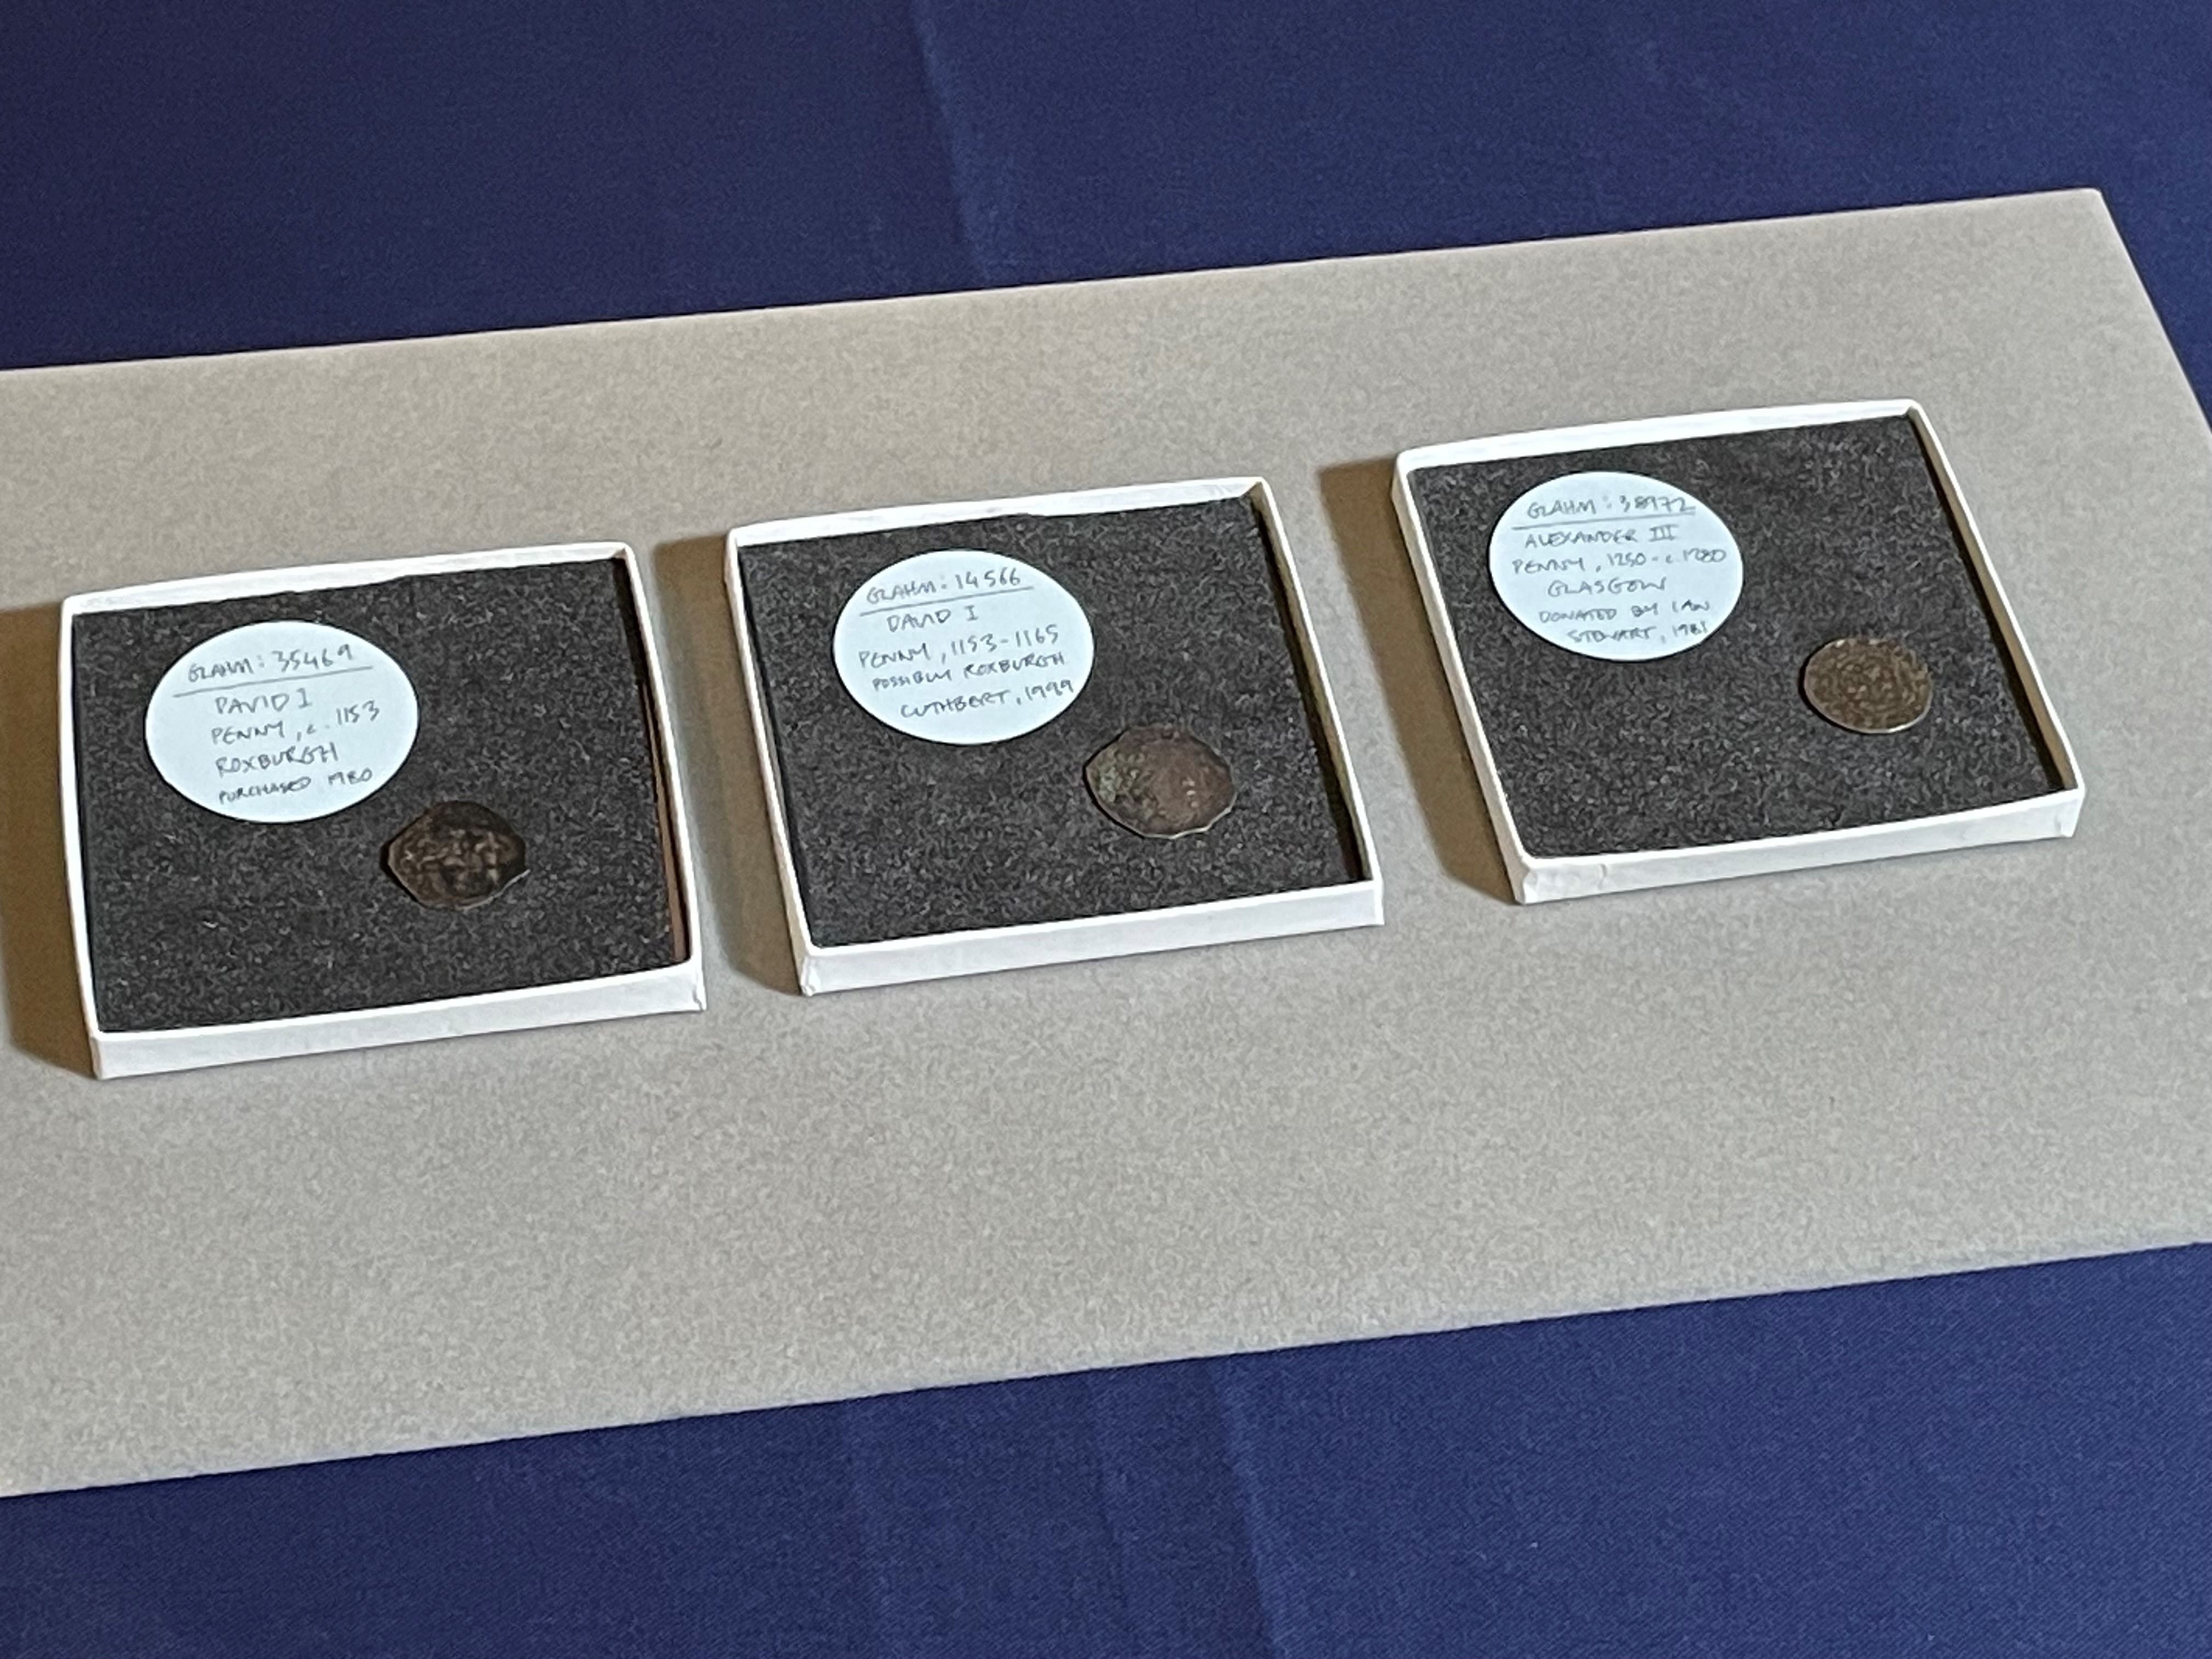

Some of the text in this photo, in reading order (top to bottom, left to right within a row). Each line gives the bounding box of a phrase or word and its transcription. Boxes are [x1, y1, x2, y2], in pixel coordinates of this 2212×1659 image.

[1525, 524, 1679, 549] ALEXANDER III
[1548, 577, 1667, 597] GLASGOW
[887, 605, 978, 632] DAVID I
[1538, 599, 1710, 623] DONATED BY IAN
[872, 651, 1065, 691] POSSIBLY ROXBURGH
[216, 688, 312, 713] DAVID I
[1025, 680, 1074, 701] 1999
[216, 742, 338, 777] ROXBURGH
[219, 777, 311, 805] PURCHASED
